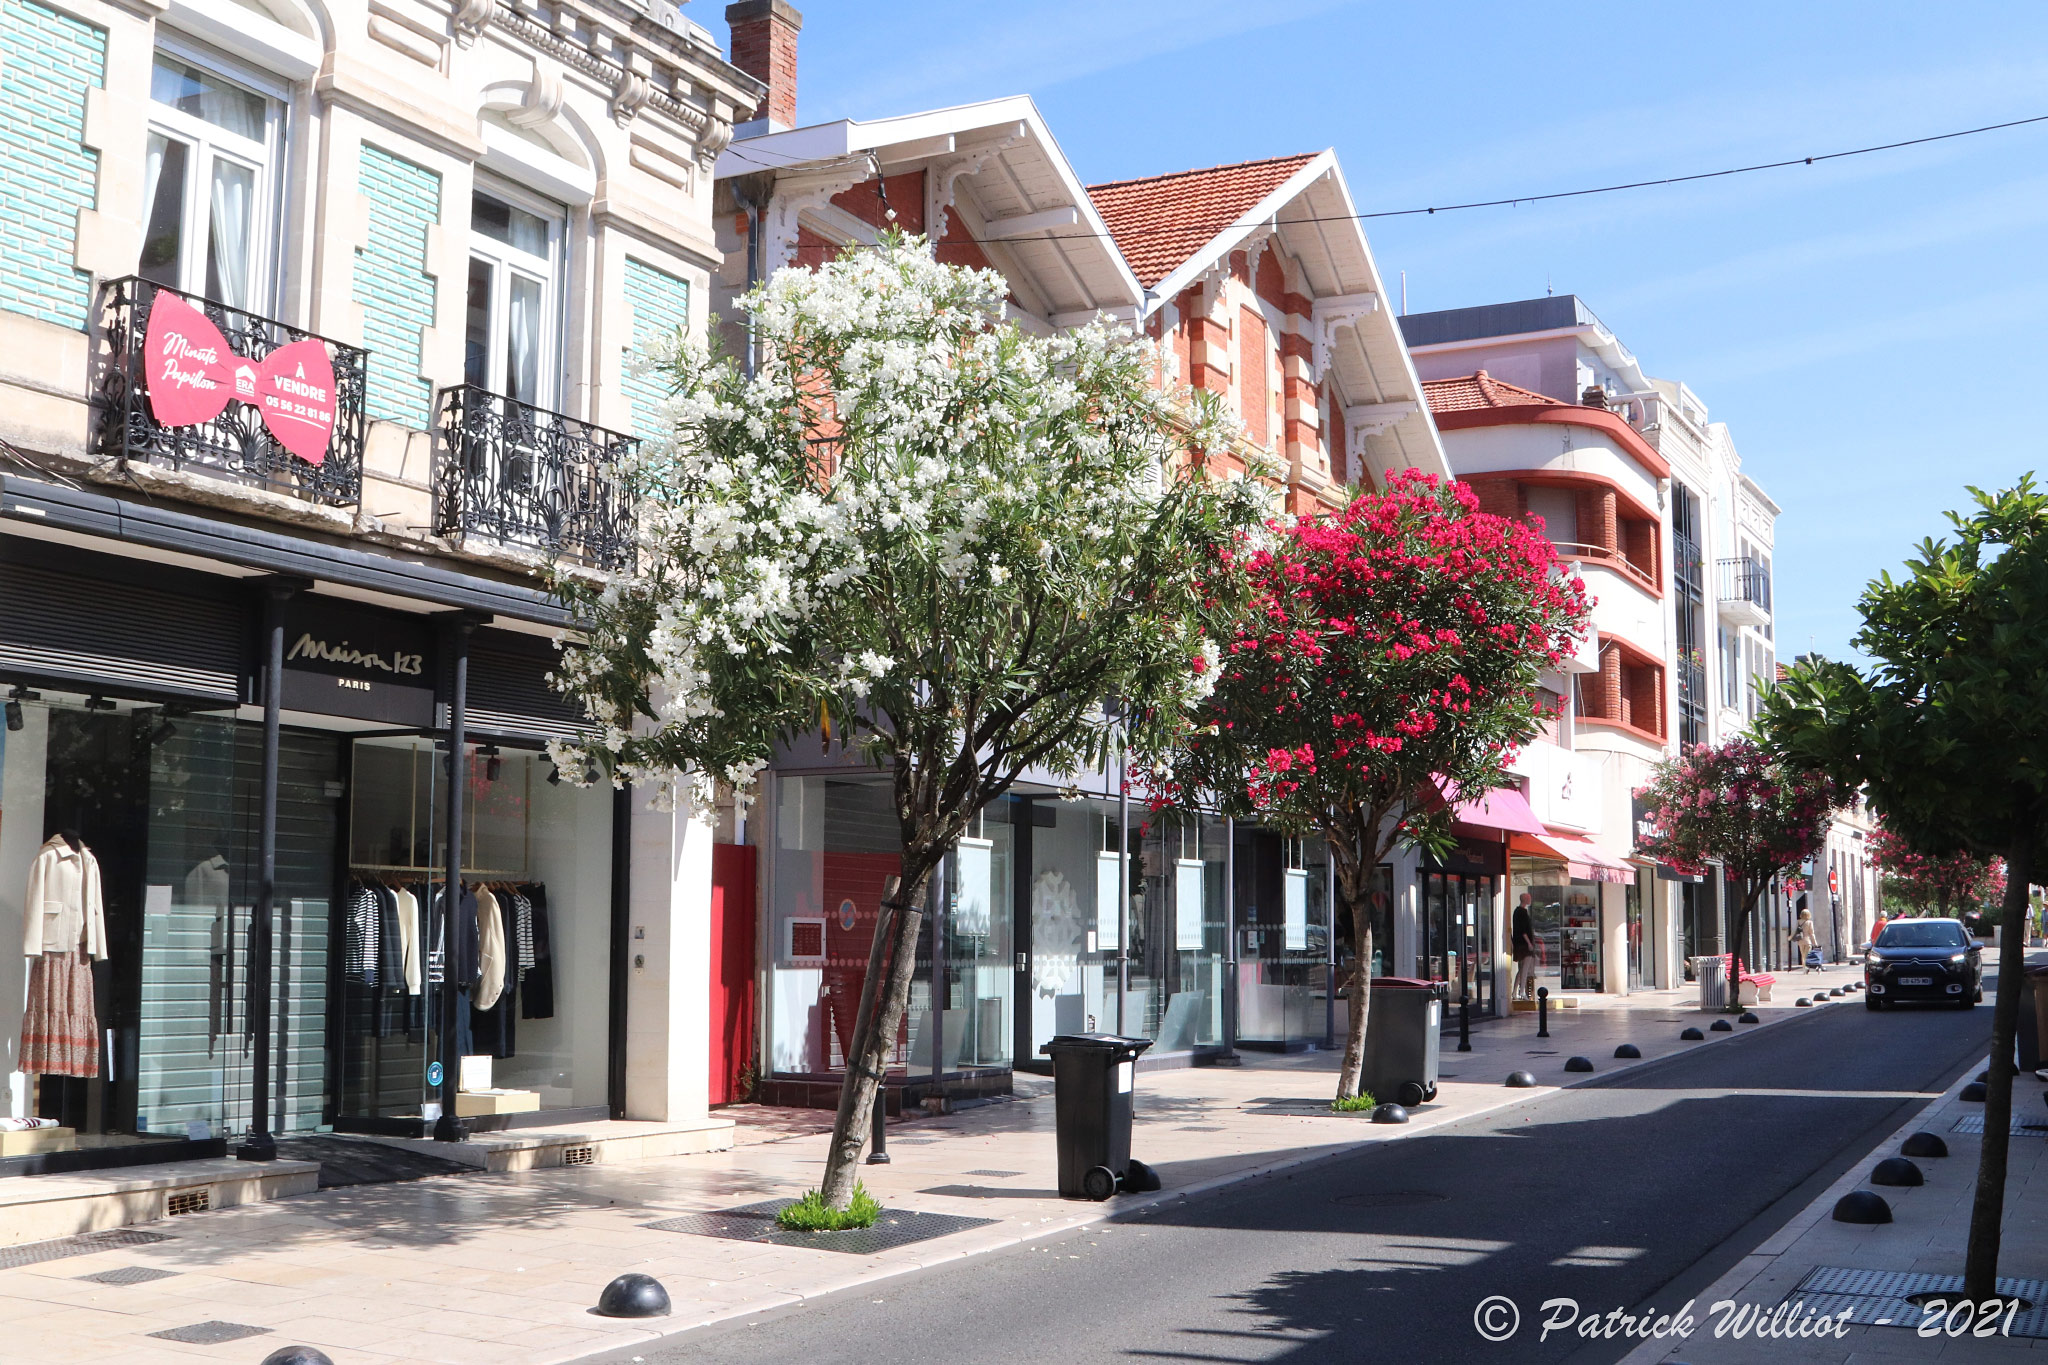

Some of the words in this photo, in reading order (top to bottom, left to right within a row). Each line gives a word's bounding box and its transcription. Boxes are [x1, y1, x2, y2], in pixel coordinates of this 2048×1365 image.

[163, 331, 218, 365] Minute
[161, 358, 218, 390] Papillon
[235, 378, 255, 391] ERA
[295, 361, 306, 380] À
[274, 374, 326, 403] VENDRE
[265, 395, 279, 408] 05
[280, 399, 293, 412] 56
[294, 403, 306, 416] 22
[307, 407, 318, 419] 81
[319, 411, 331, 423] 86
[286, 632, 393, 672] Maison
[338, 678, 371, 691] PARIS
